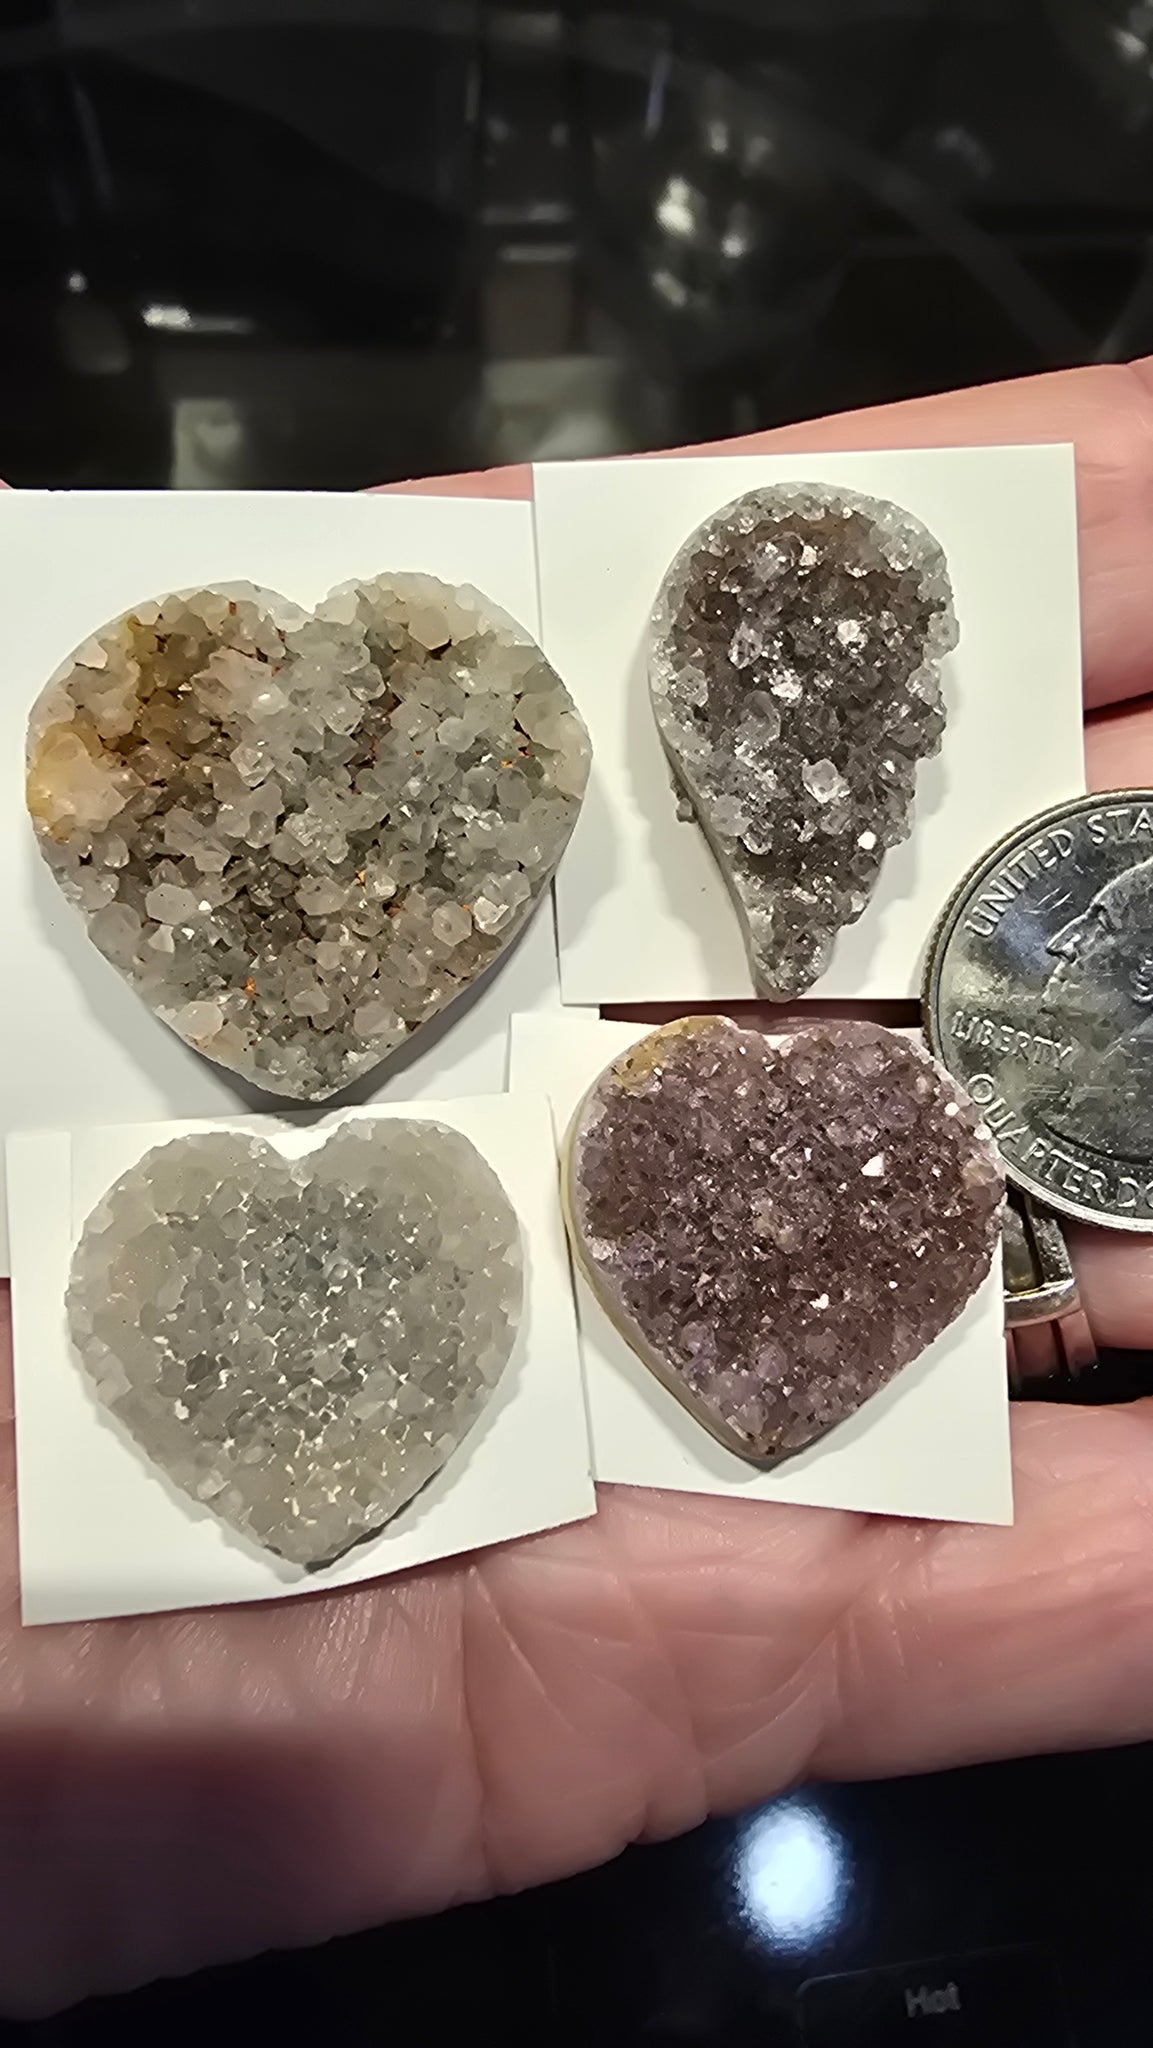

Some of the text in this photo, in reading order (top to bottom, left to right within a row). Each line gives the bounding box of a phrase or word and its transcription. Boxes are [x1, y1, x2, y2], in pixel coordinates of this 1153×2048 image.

[964, 808, 1153, 939] UNITED STA
[951, 1009, 1074, 1070] LIBERTY
[967, 1073, 1108, 1205] QUARTER
[905, 1982, 961, 2018] Hot
